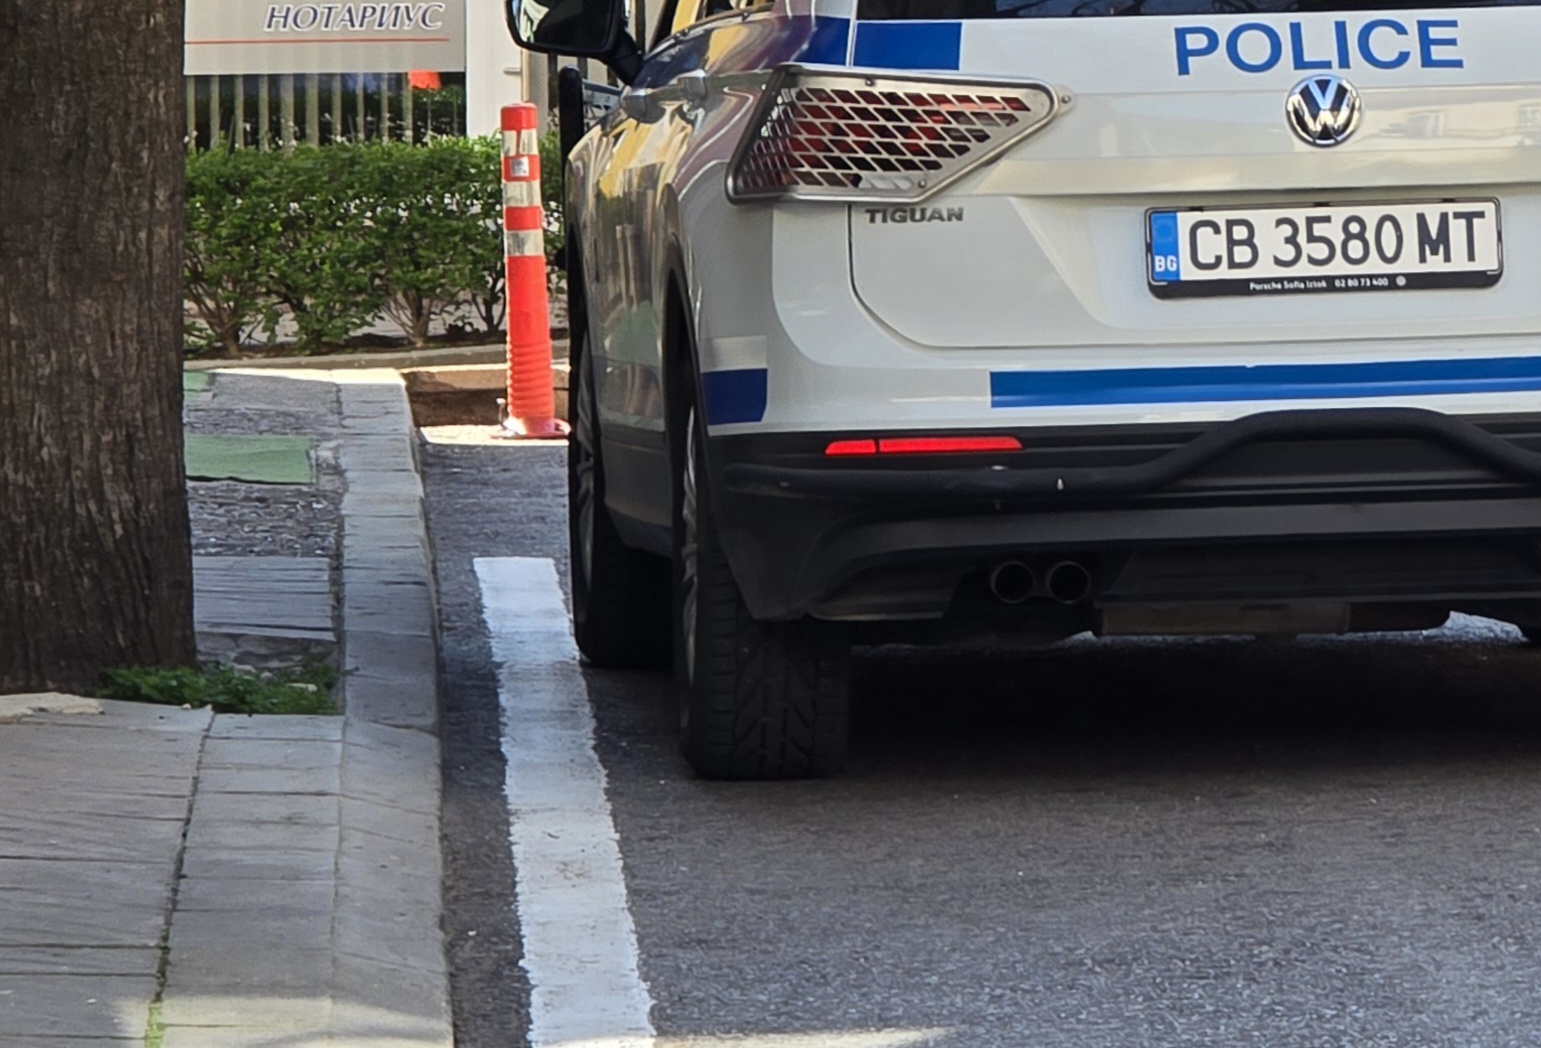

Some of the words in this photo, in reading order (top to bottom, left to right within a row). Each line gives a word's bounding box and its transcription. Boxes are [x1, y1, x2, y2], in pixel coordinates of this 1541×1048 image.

[265, 3, 446, 31] НОТАРИУС
[1174, 19, 1464, 76] POLICE
[866, 208, 964, 224] TIGUAN
[1189, 219, 1259, 270] CB
[1273, 213, 1404, 268] 3580
[1416, 210, 1485, 264] MT
[1154, 255, 1177, 272] BG
